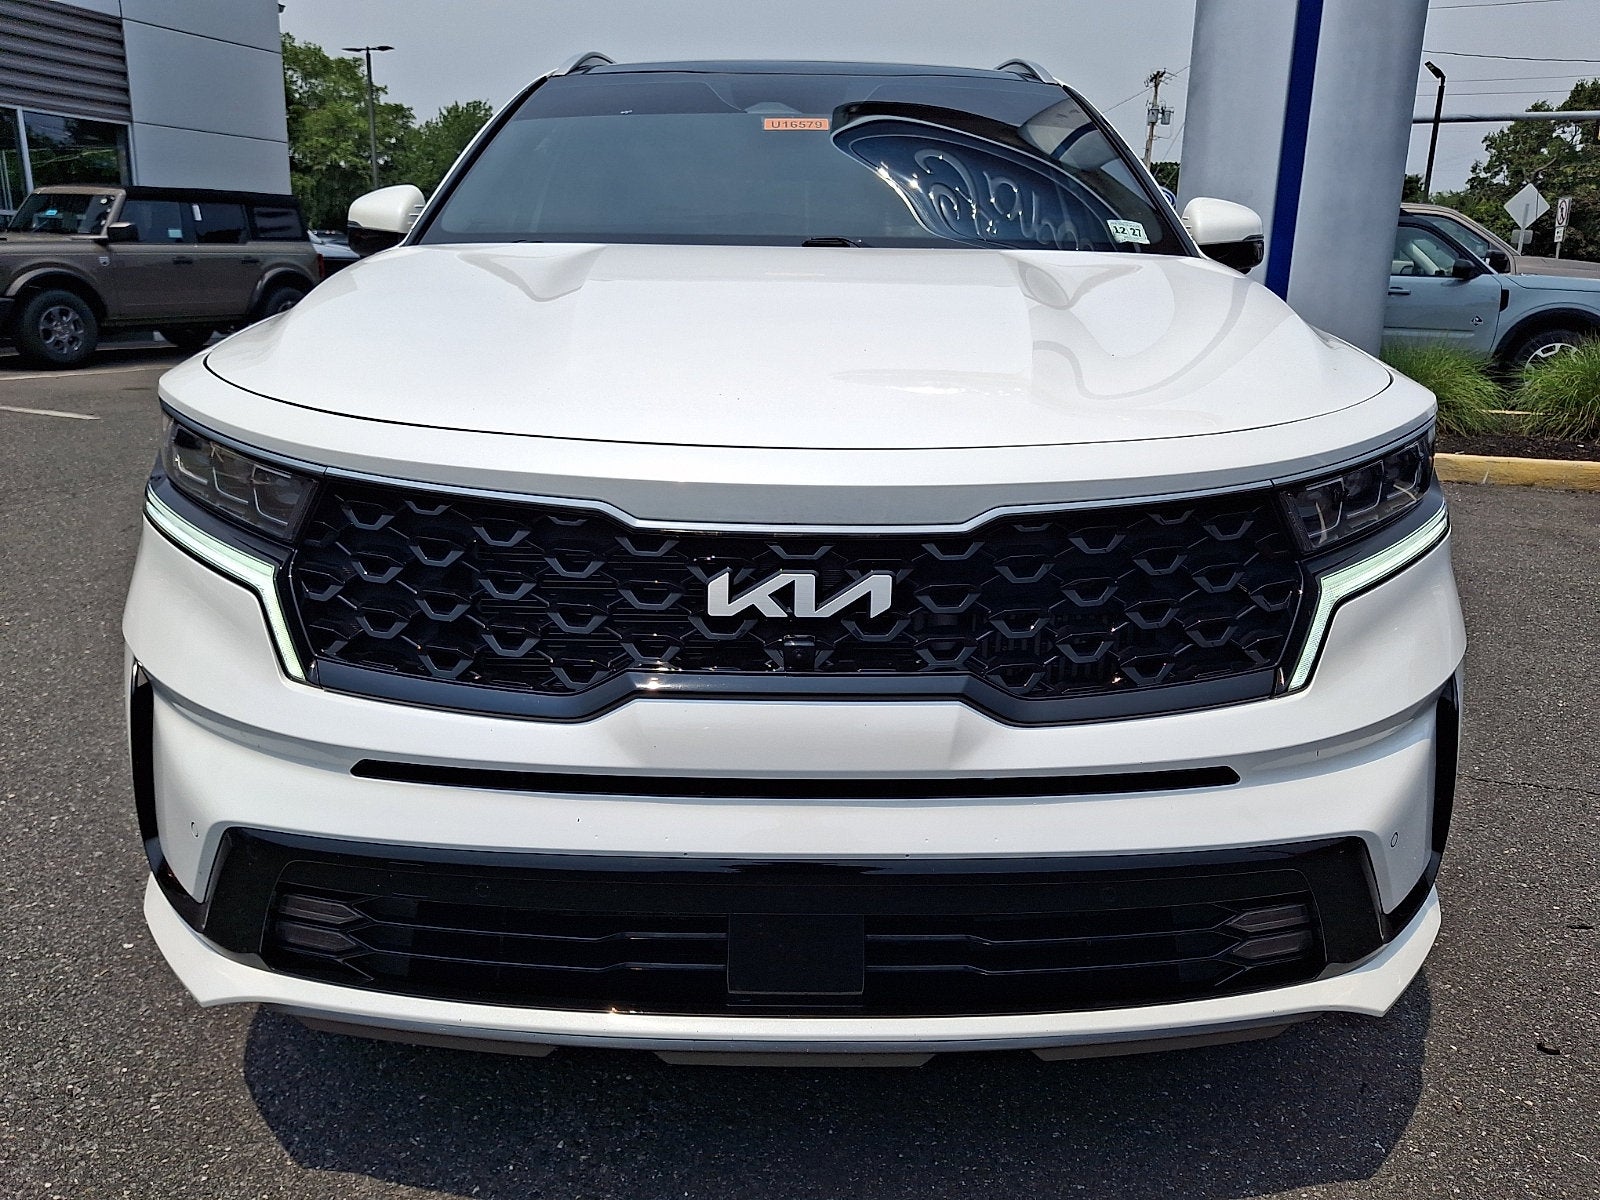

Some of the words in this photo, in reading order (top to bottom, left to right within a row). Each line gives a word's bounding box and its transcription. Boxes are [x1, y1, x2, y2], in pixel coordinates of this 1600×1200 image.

[771, 120, 823, 129] U16579
[1113, 225, 1127, 235] 12
[1129, 227, 1142, 237] 27
[707, 571, 893, 618] KIA
